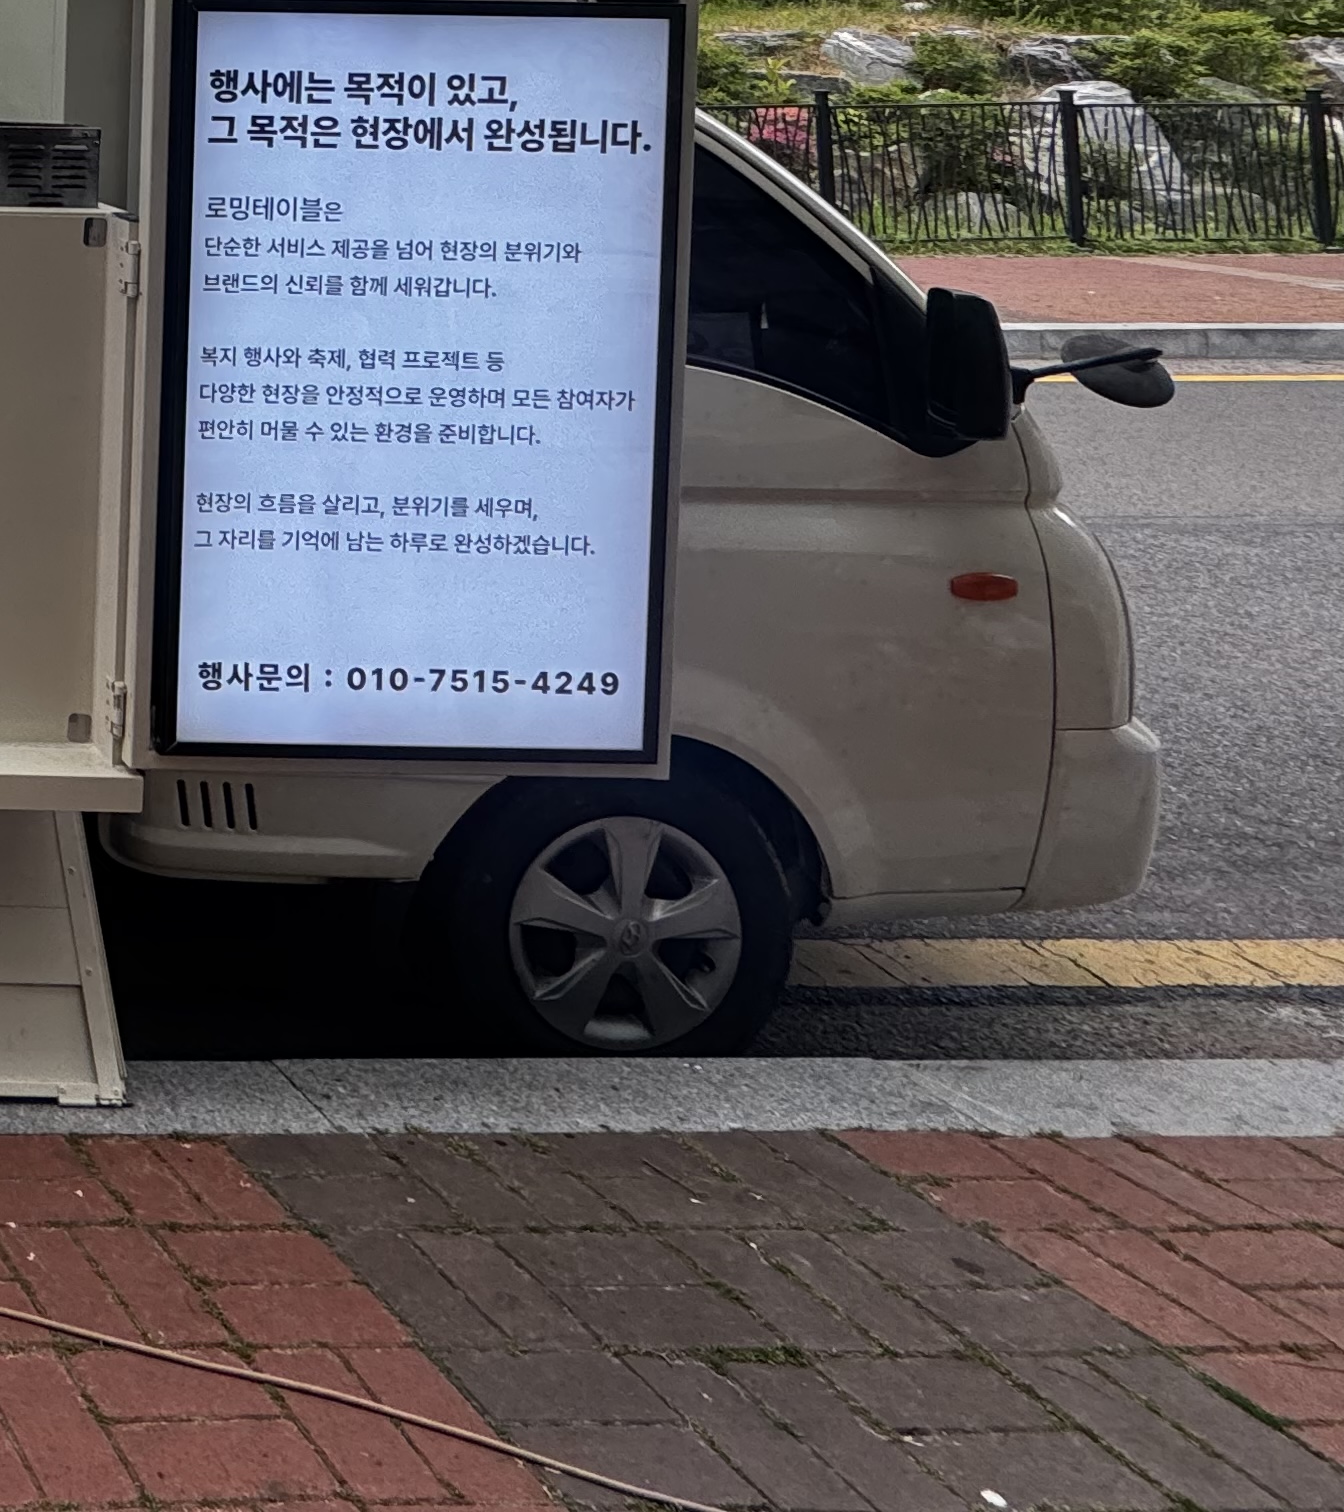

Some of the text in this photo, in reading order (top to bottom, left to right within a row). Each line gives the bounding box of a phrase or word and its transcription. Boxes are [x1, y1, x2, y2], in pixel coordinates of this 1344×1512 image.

[209, 69, 519, 113] 행사에는 목적이 있고,
[207, 114, 653, 156] 그 목적은 현장에서 완성됩니다.
[204, 195, 345, 223] 로밍테이블은
[204, 235, 583, 264] 단순한 서비스 제공을 넘어 현장의 분위기와
[202, 272, 498, 300] 브랜드의 신뢰를 함께 세워갑니다.
[199, 345, 506, 373] 복지 행사와 축제, 협력 프로젝트 등
[199, 382, 637, 412] 다양한 현장을 안정적으로 운영하며 모든 참여자가
[197, 418, 542, 447] 편안히 머물 수 있는 환경을 준비합니다.
[195, 491, 539, 522] 현장의 흐름을 살리고, 분위기를 세우며,
[193, 527, 597, 557] 그 자리를 기억에 남는 하루로 완성하겠습니다.
[197, 661, 310, 694] 행사문의
[346, 666, 621, 696] 010-7515-4249
